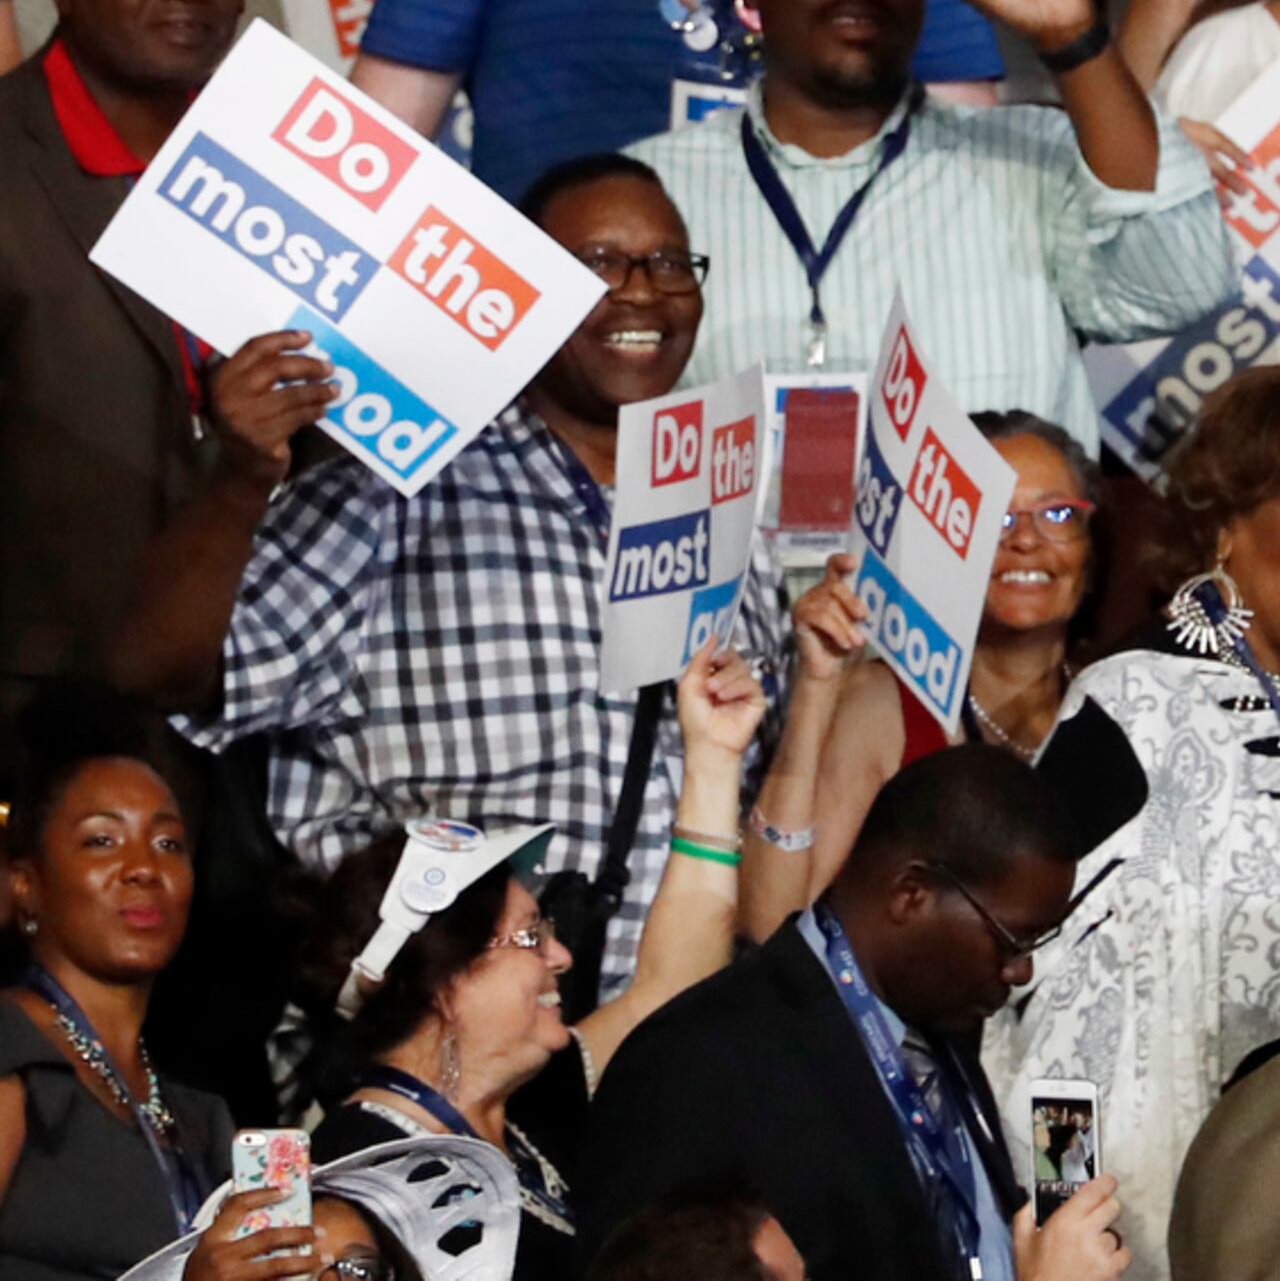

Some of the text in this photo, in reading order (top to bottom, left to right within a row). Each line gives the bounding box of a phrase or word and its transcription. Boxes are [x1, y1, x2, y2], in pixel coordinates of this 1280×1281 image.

[283, 88, 390, 194] Do
[167, 154, 361, 312] most
[402, 222, 516, 340] the
[295, 341, 449, 473] ood
[885, 334, 916, 428] Do
[655, 414, 699, 481] Do
[712, 426, 754, 500] the
[912, 444, 973, 549] the
[614, 521, 708, 598] most
[858, 578, 958, 706] good
